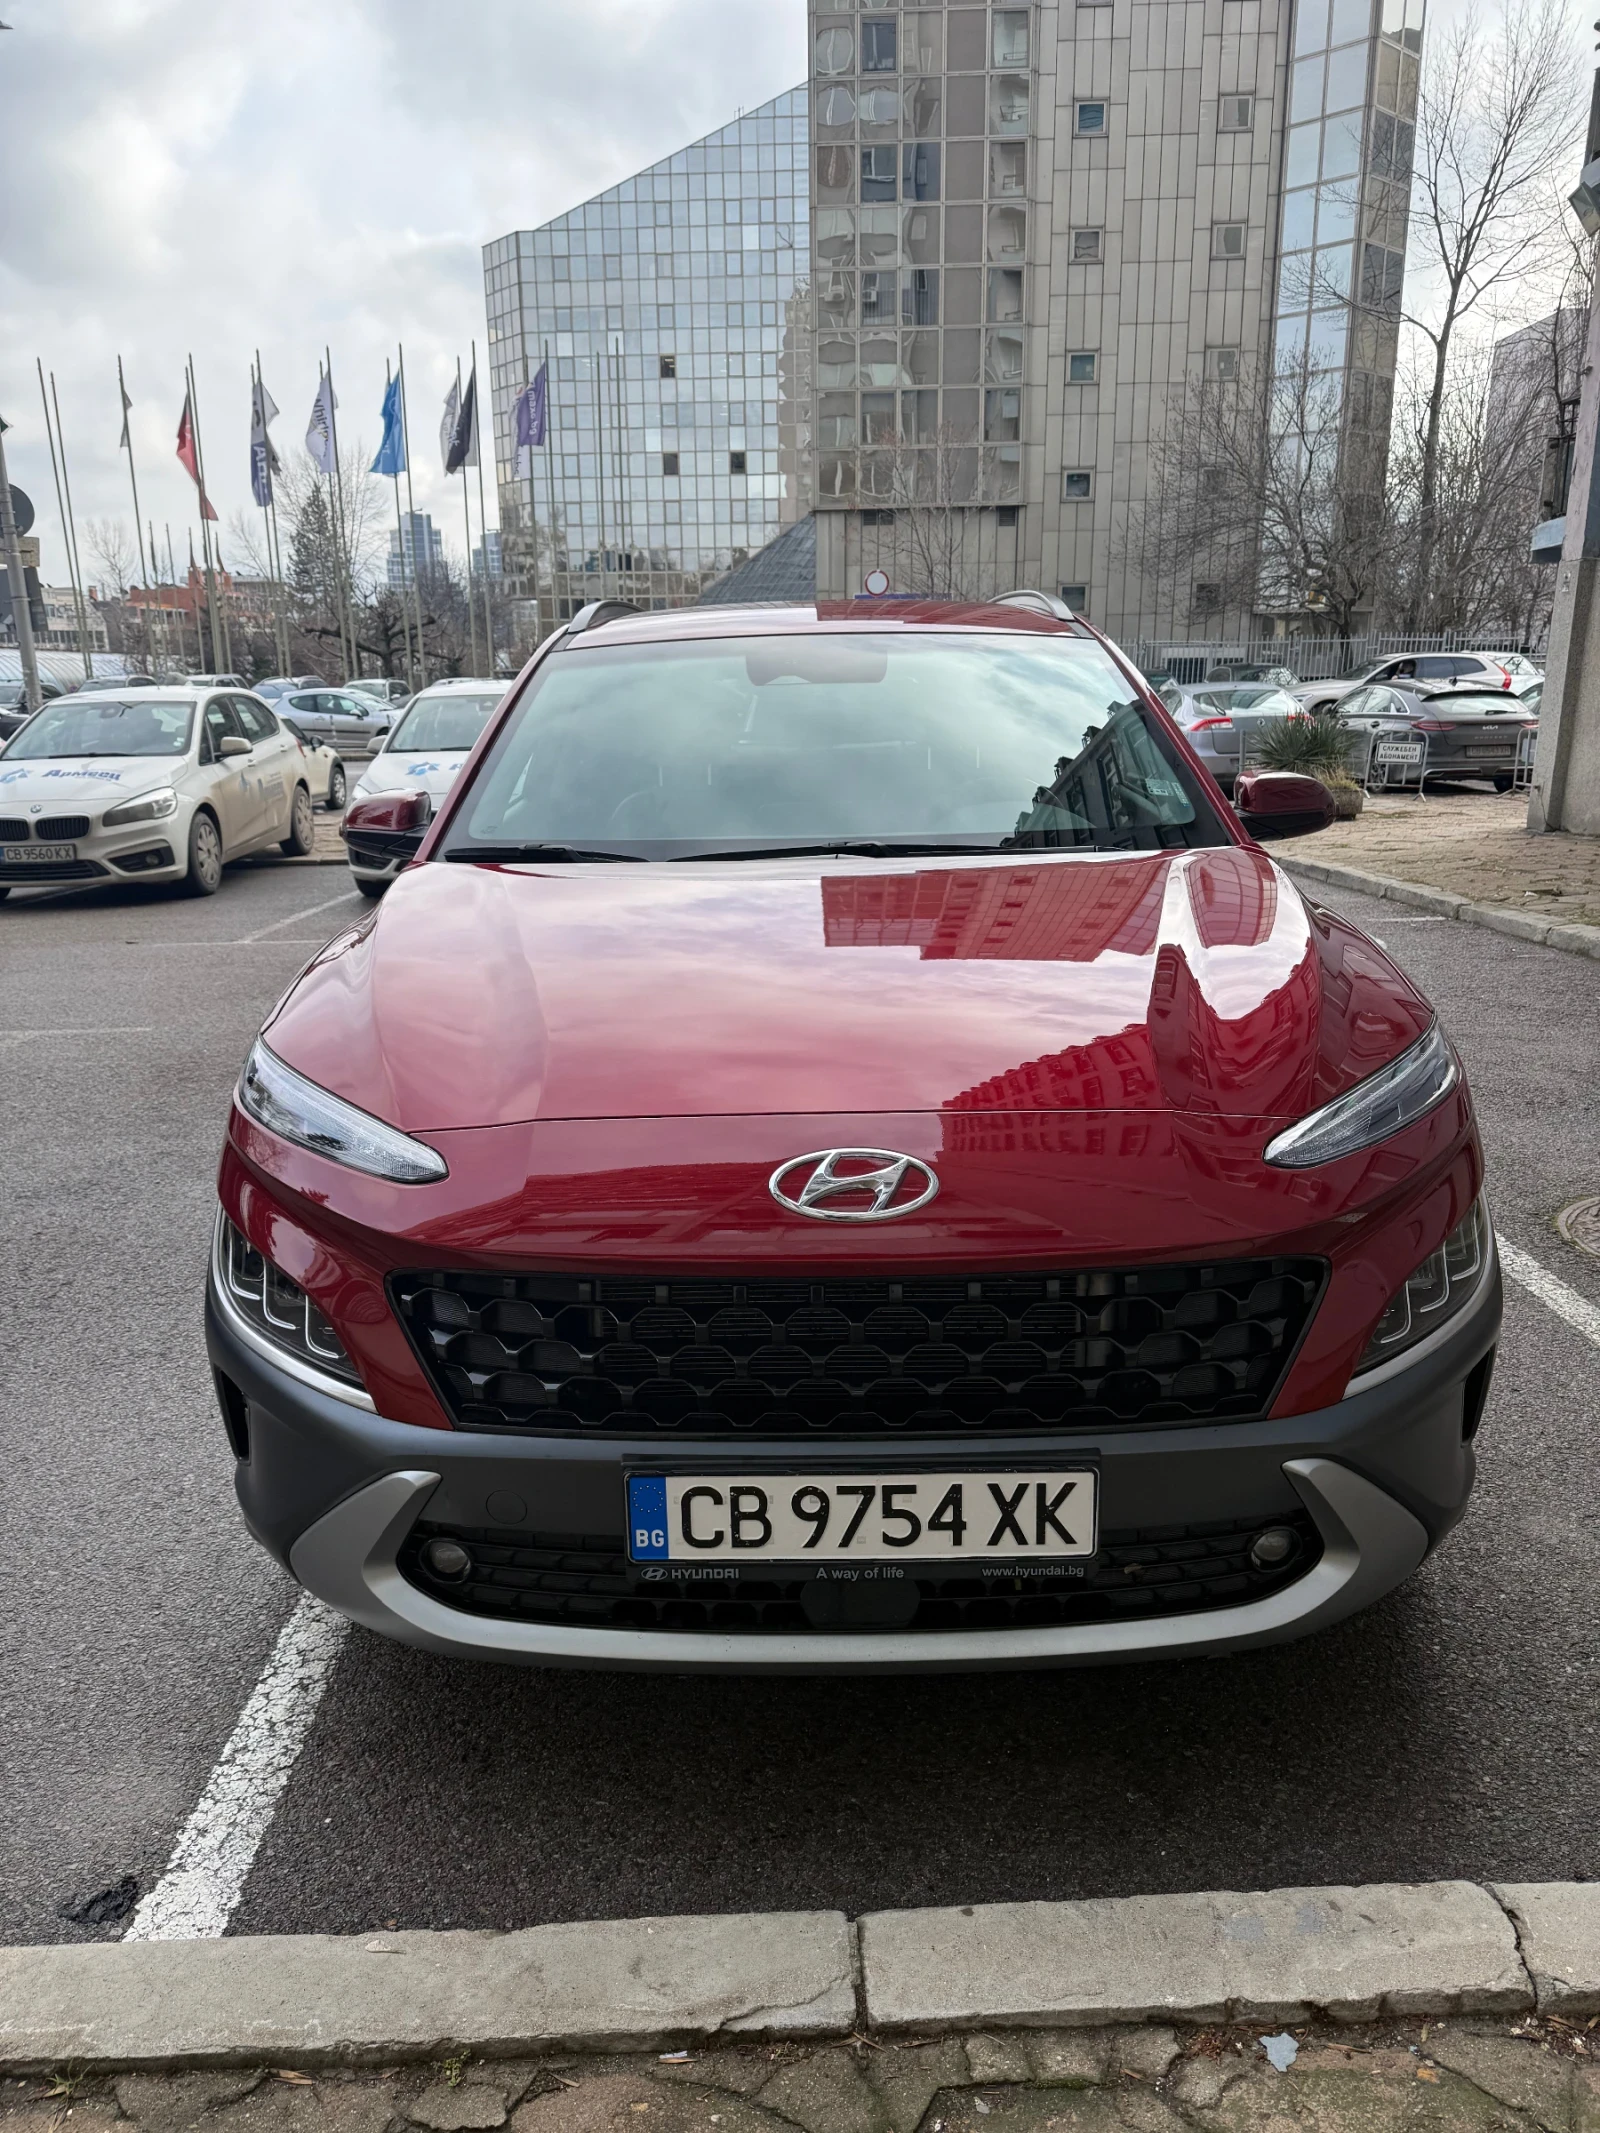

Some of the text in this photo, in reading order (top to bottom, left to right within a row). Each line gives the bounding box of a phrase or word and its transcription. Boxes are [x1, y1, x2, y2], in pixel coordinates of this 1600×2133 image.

[1382, 745, 1417, 753] СЛУЖЕБЕН
[1379, 753, 1418, 761] АБОНАМЕНТ
[6, 847, 72, 860] CB 9560 KX
[681, 1482, 1078, 1548] CB 9754 XK
[635, 1529, 665, 1548] BG
[671, 1568, 740, 1580] HYUNDAI
[815, 1566, 905, 1583] A way of life
[981, 1565, 1084, 1578] www.hyundai.bg
